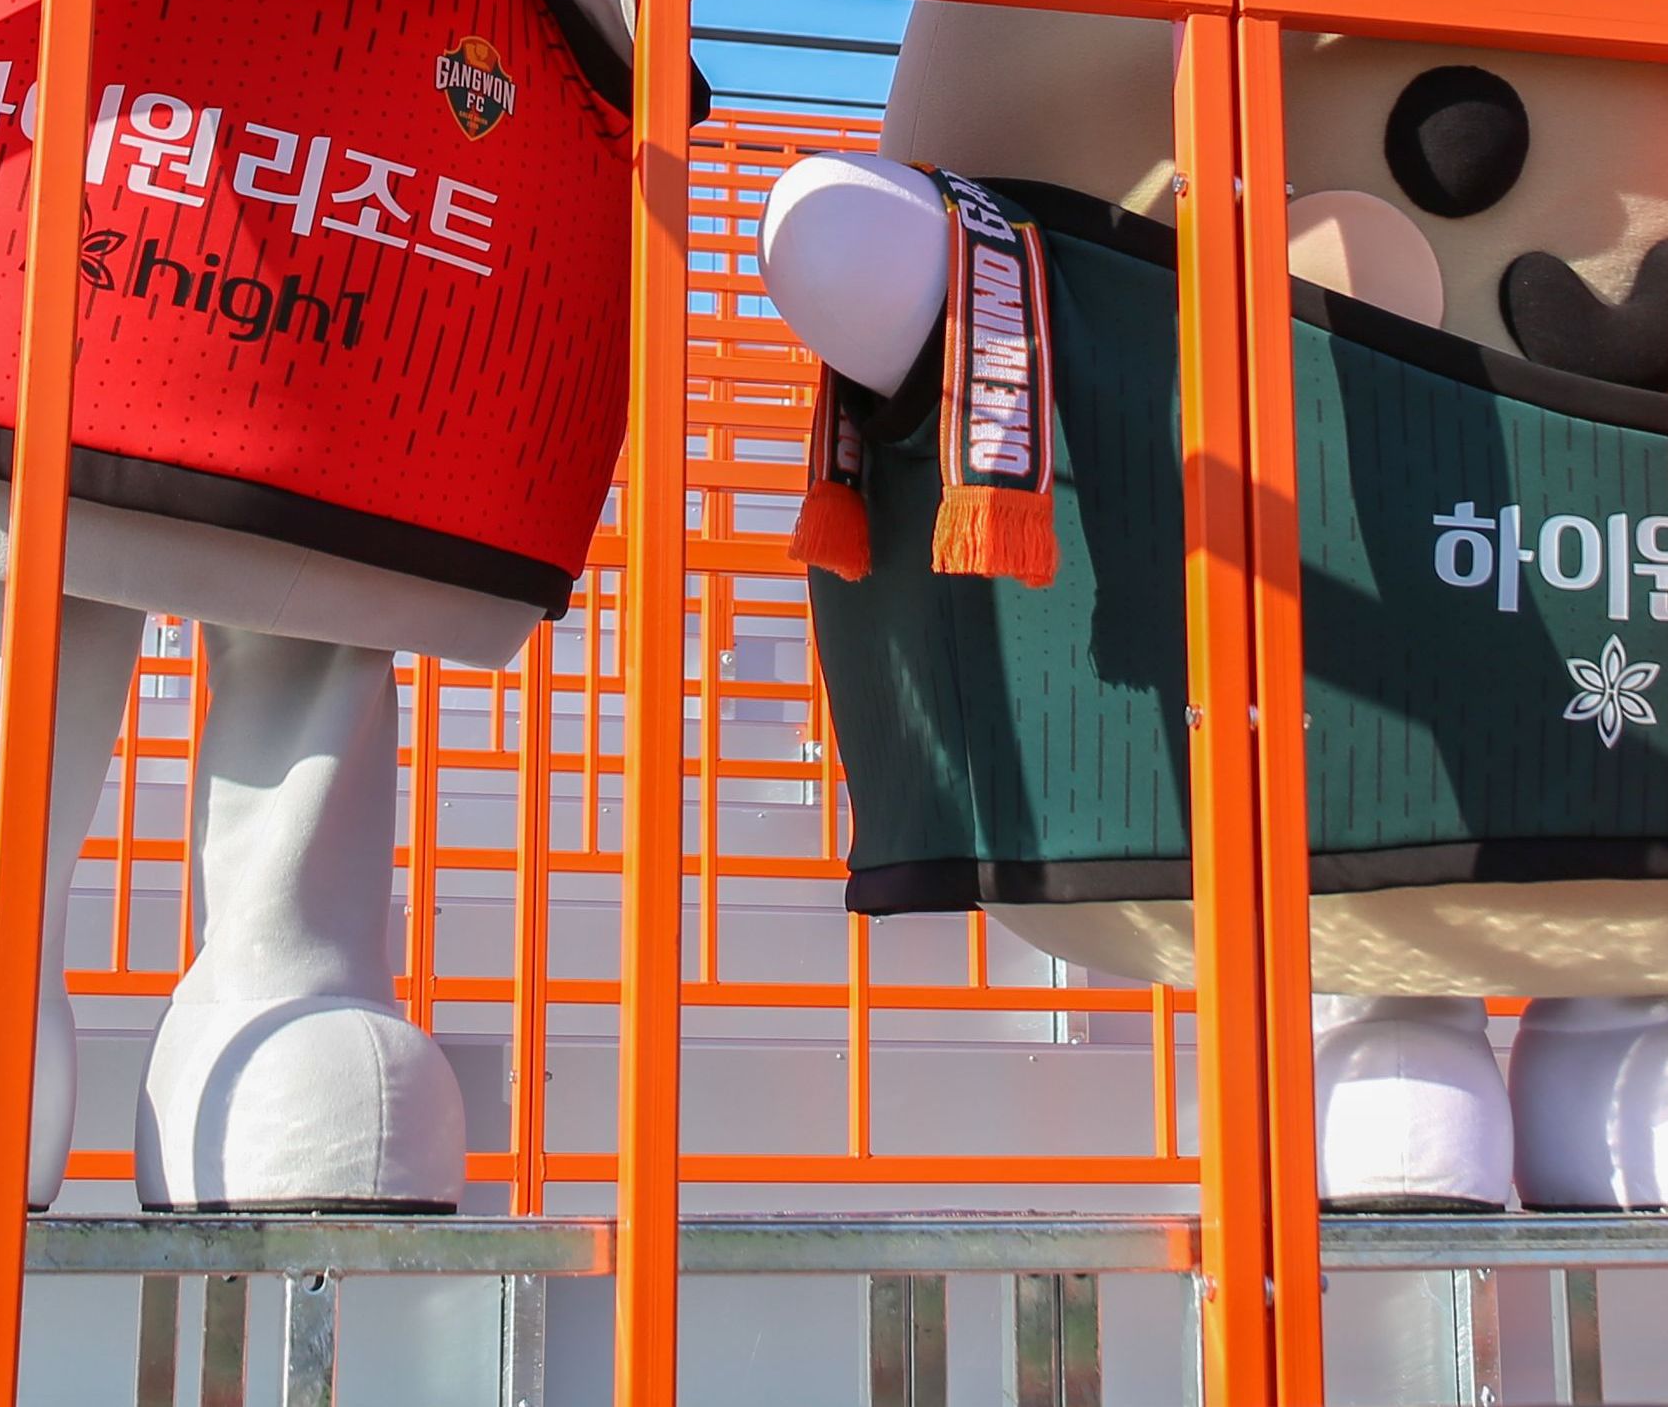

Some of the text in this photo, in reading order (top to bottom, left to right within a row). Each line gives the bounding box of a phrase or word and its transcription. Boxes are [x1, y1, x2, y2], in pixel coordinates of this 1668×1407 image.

[436, 55, 516, 116] GANGWON
[466, 92, 485, 113] FC
[132, 238, 365, 351] high1
[969, 244, 1030, 477] ONE MIND
